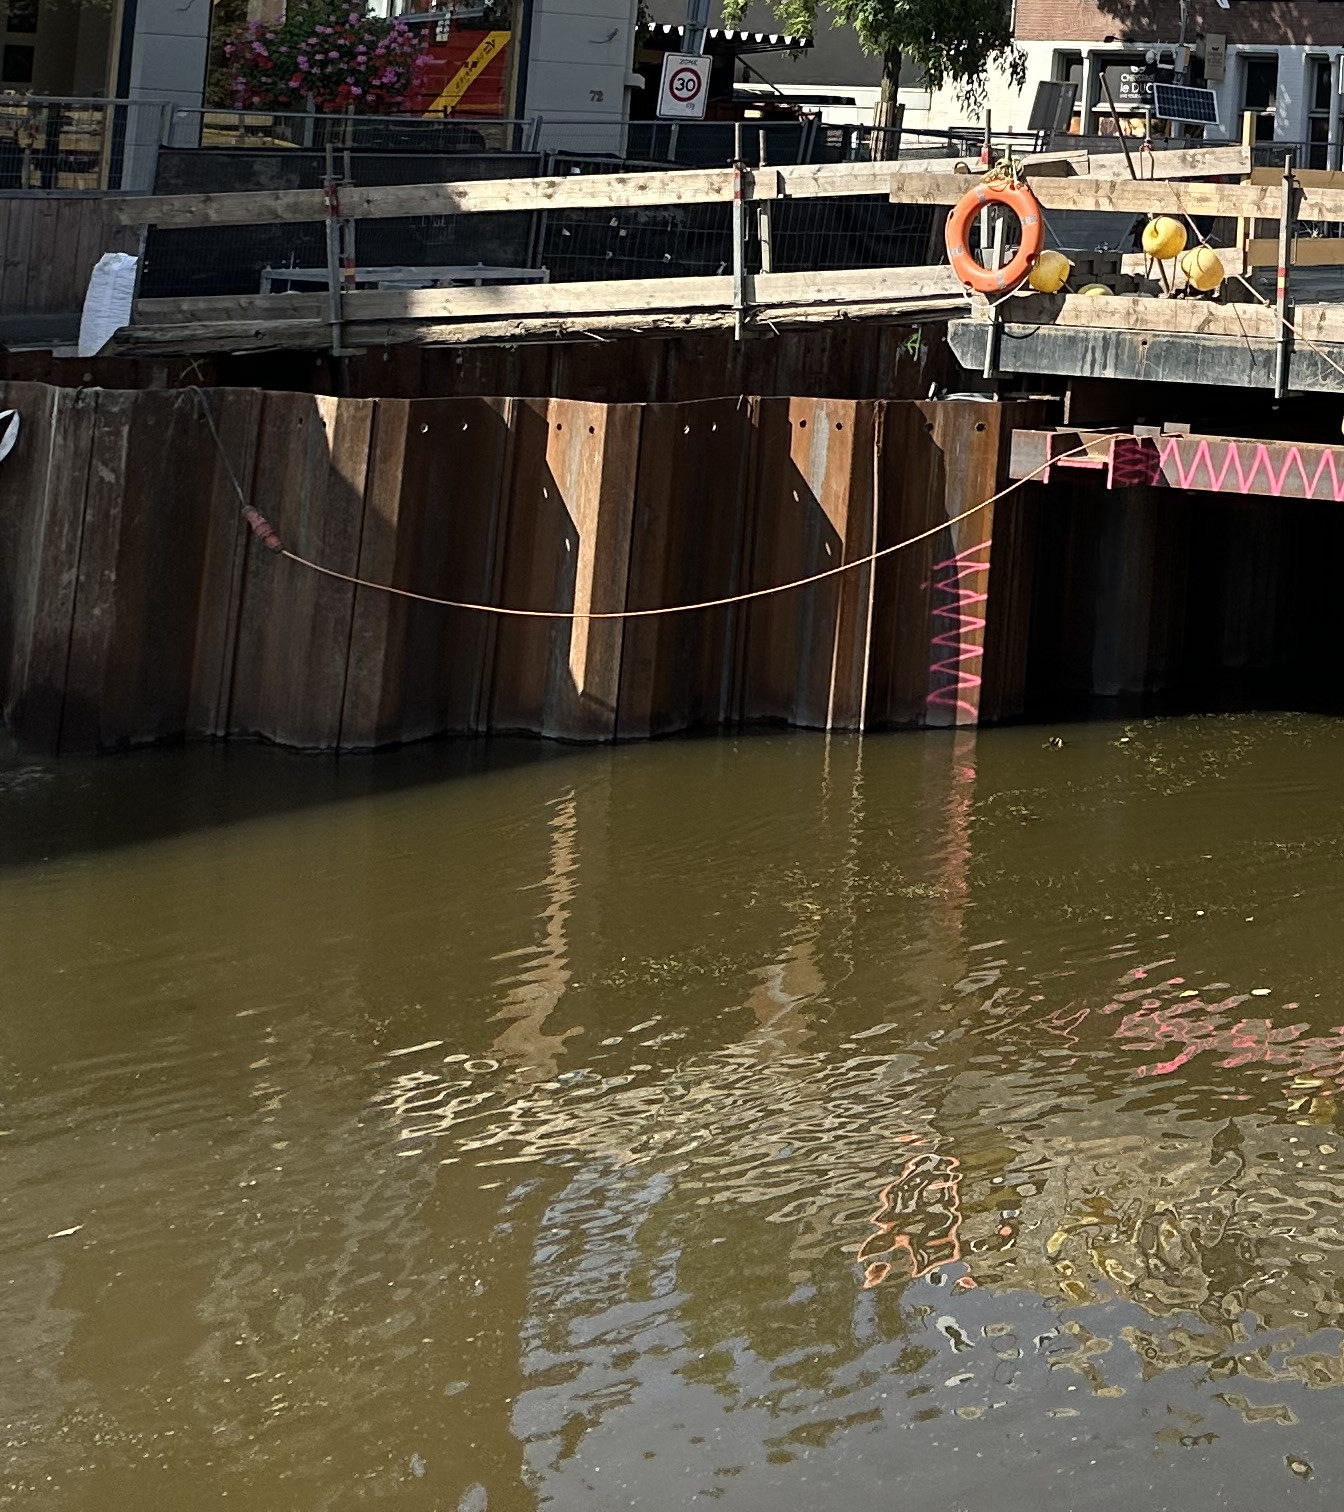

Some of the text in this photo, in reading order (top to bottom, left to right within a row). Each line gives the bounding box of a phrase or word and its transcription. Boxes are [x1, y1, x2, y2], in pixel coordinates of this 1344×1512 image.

[675, 77, 696, 93] 30
[1131, 82, 1154, 94] DUC
[589, 89, 604, 103] 72
